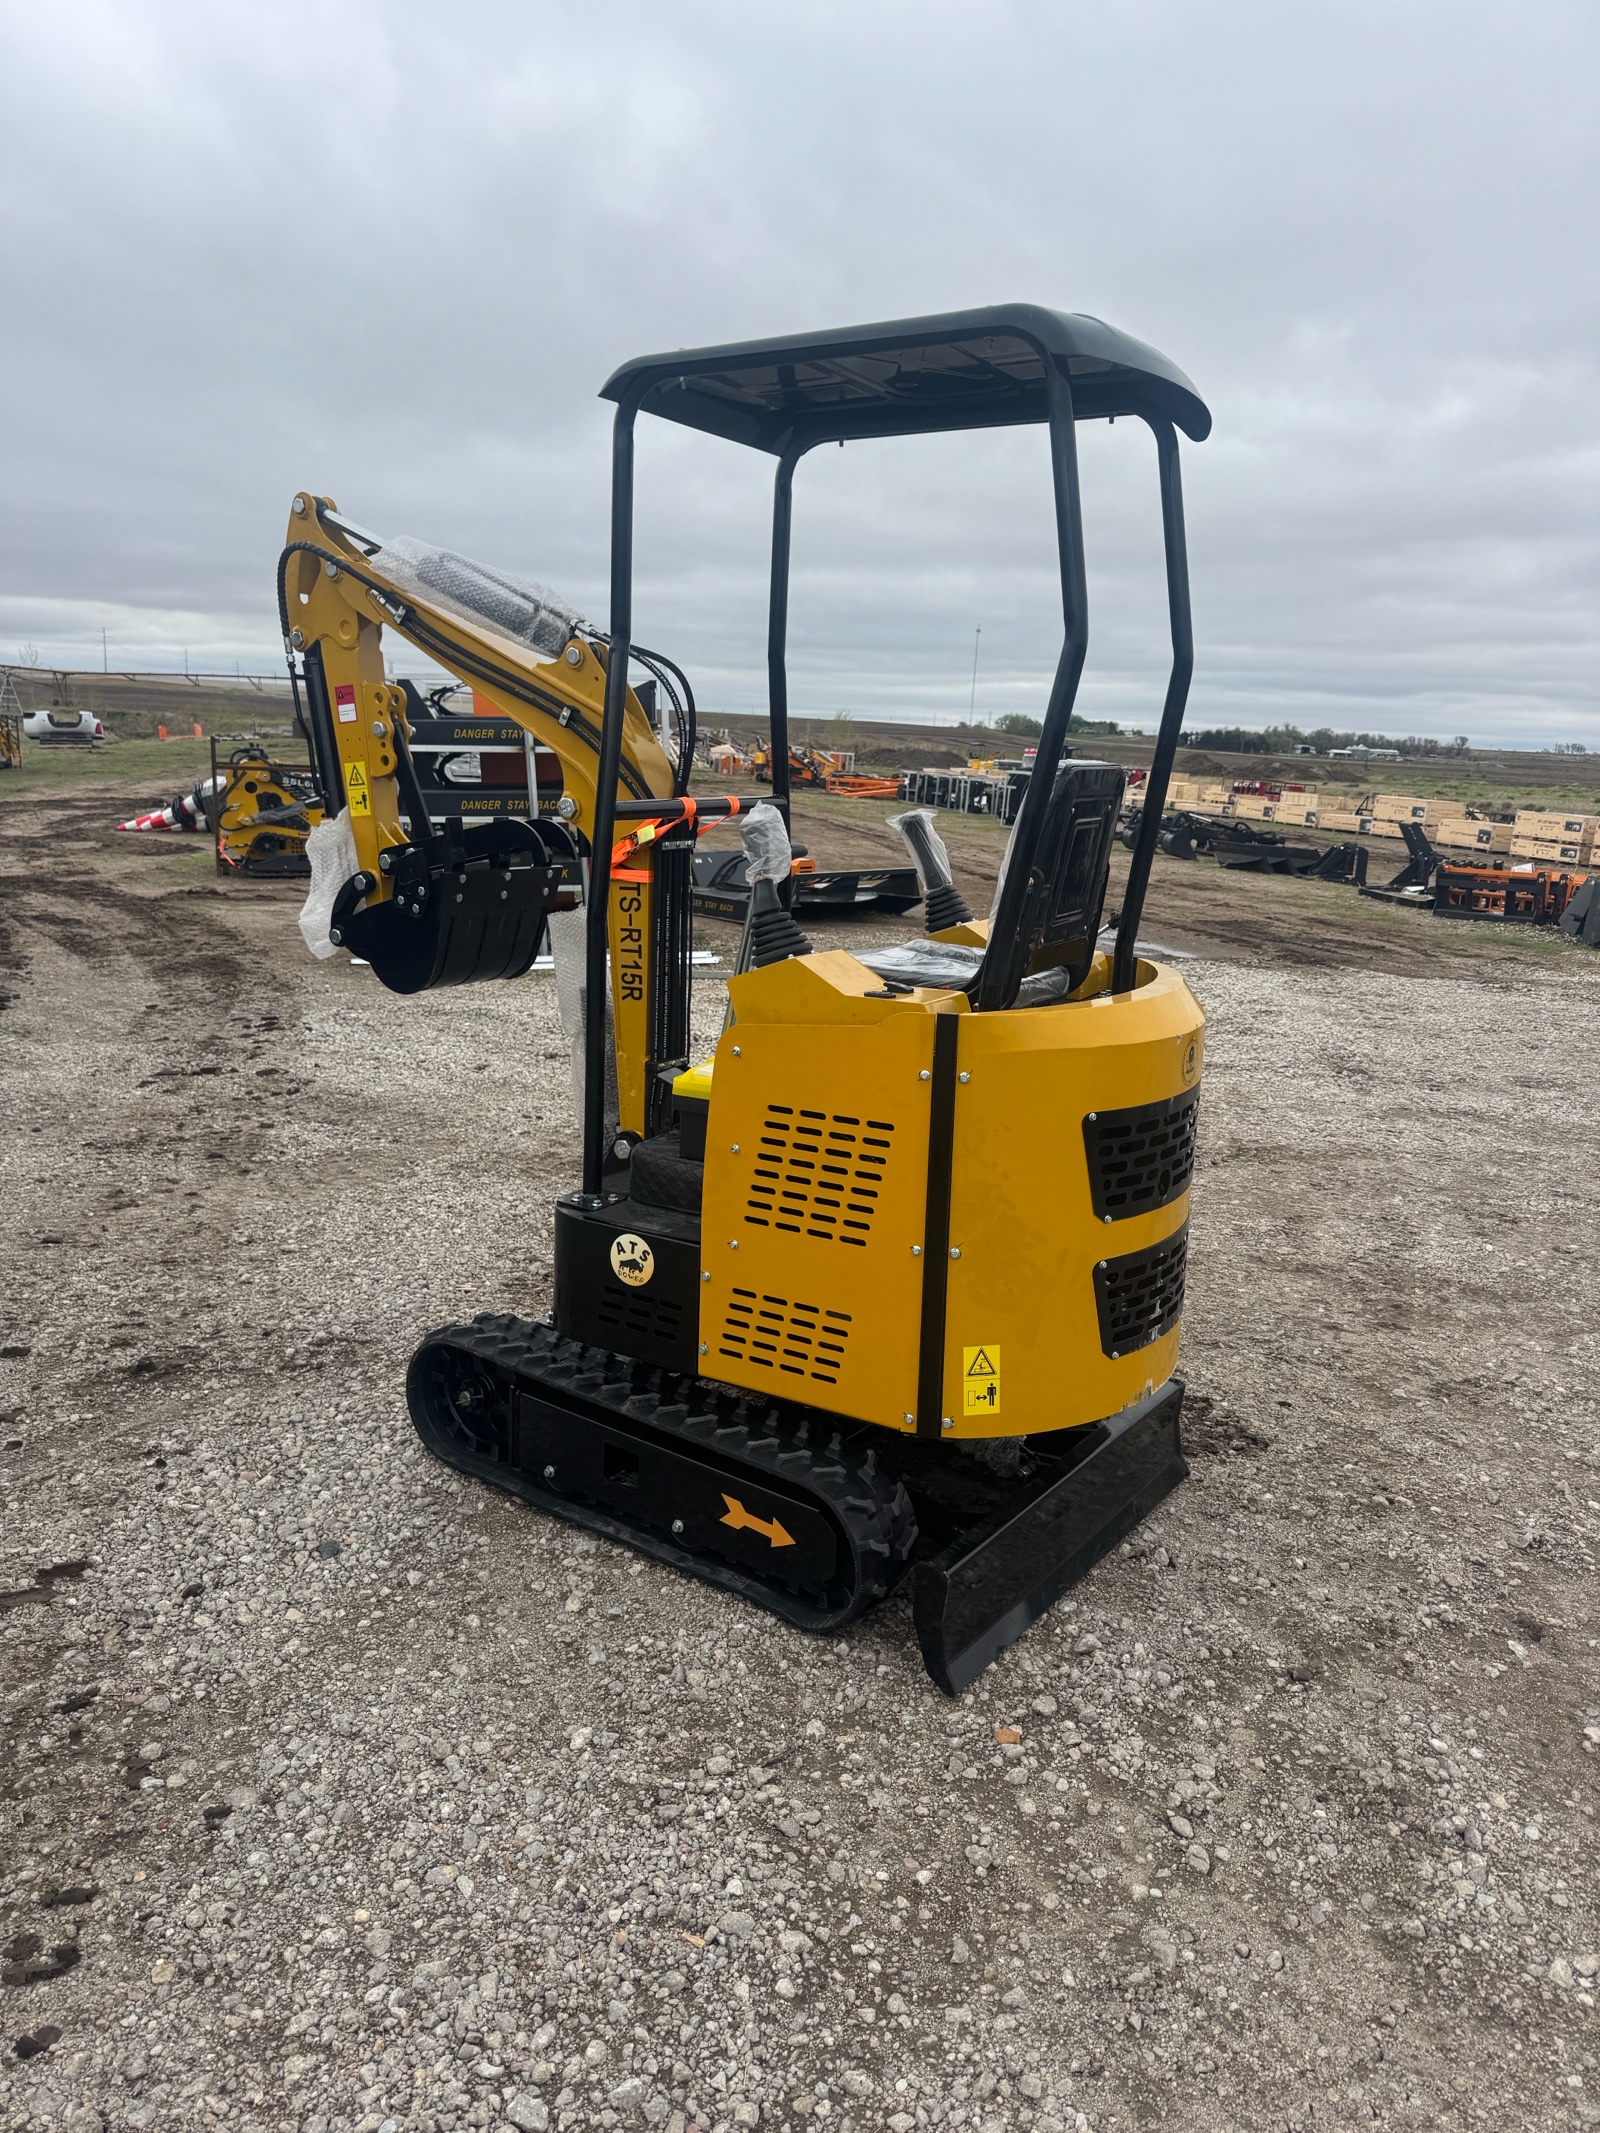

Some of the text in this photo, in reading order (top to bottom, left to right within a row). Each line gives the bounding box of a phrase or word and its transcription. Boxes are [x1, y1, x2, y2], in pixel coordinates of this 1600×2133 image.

[454, 729, 525, 739] DANGER STAY
[461, 800, 501, 810] DANGER
[507, 800, 530, 810] STAY
[704, 901, 717, 909] STAY
[720, 903, 734, 912] BACK
[619, 882, 643, 1001] TS-RT15R
[616, 1240, 650, 1262] ATS
[618, 1269, 645, 1283] POWER
